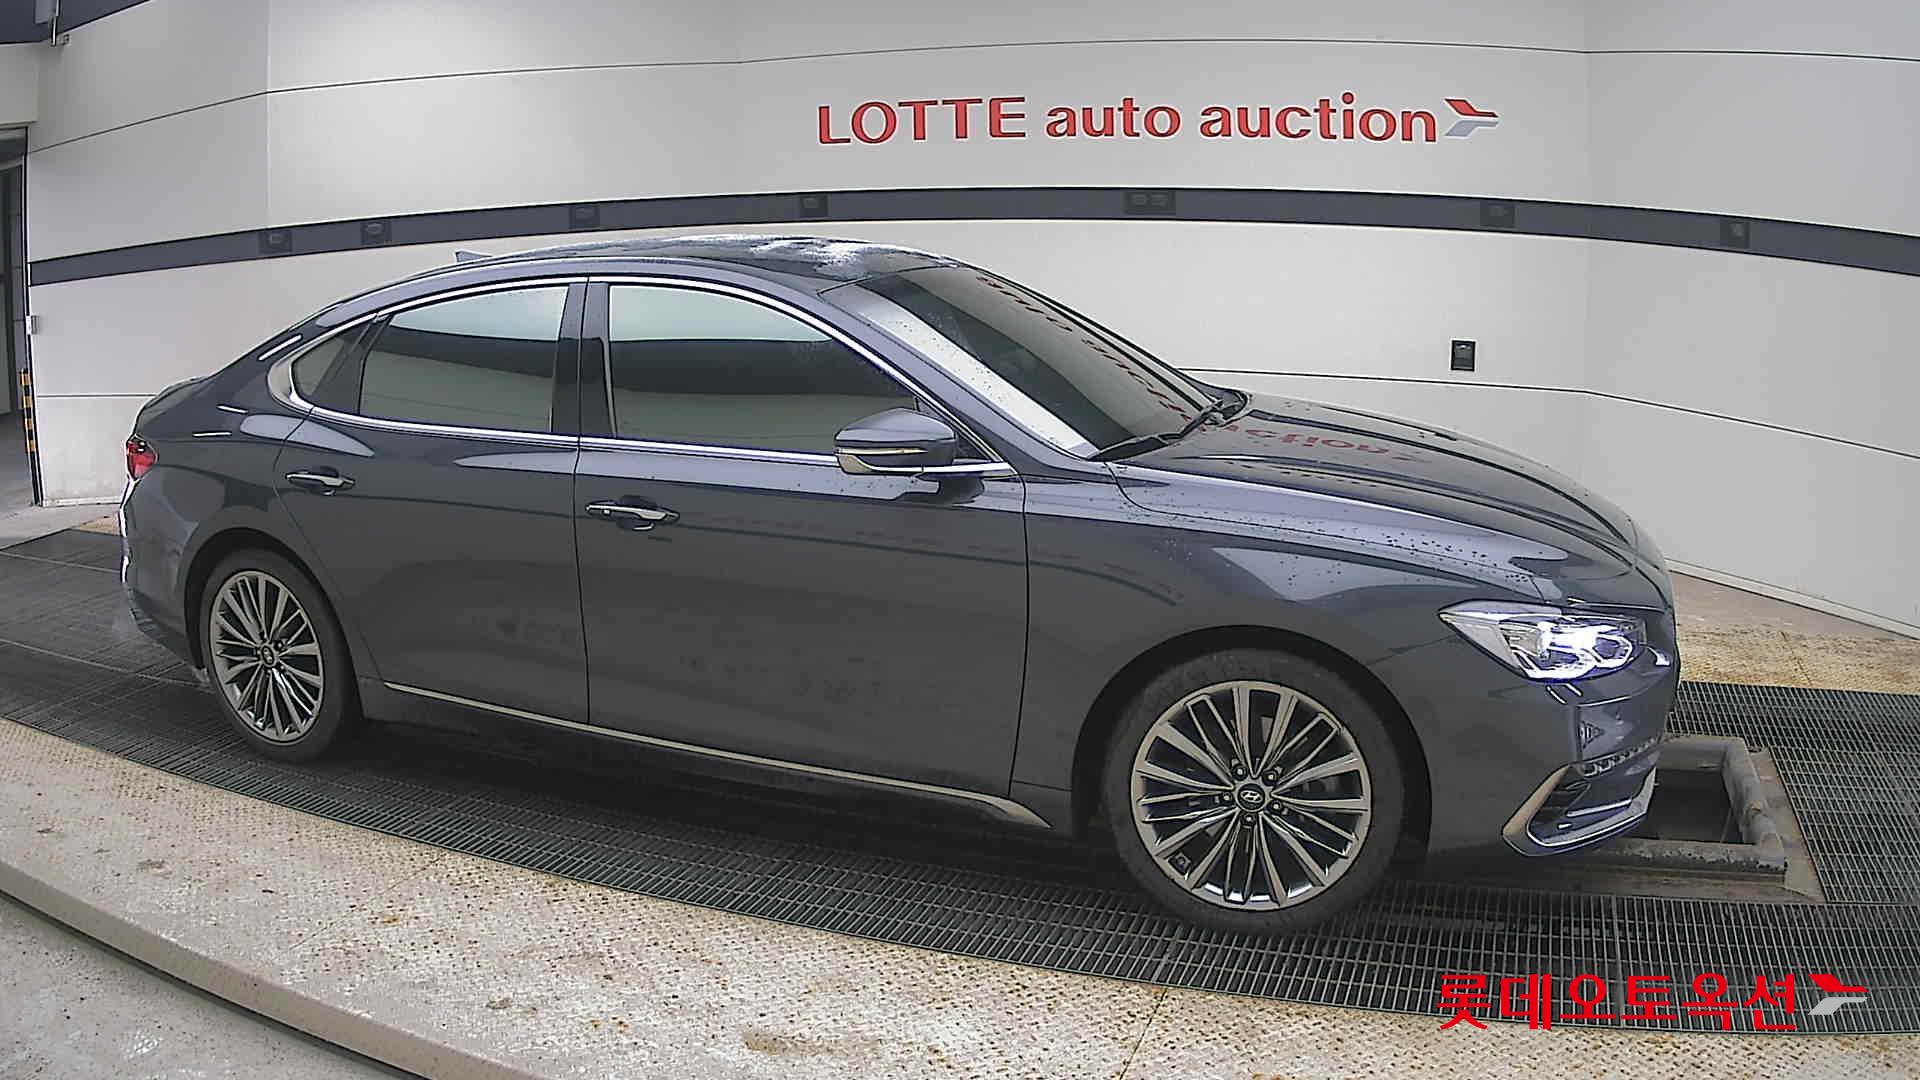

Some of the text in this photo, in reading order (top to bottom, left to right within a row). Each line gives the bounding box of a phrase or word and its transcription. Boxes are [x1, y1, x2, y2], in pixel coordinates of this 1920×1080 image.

[818, 92, 1437, 144] LOTTE auto auction
